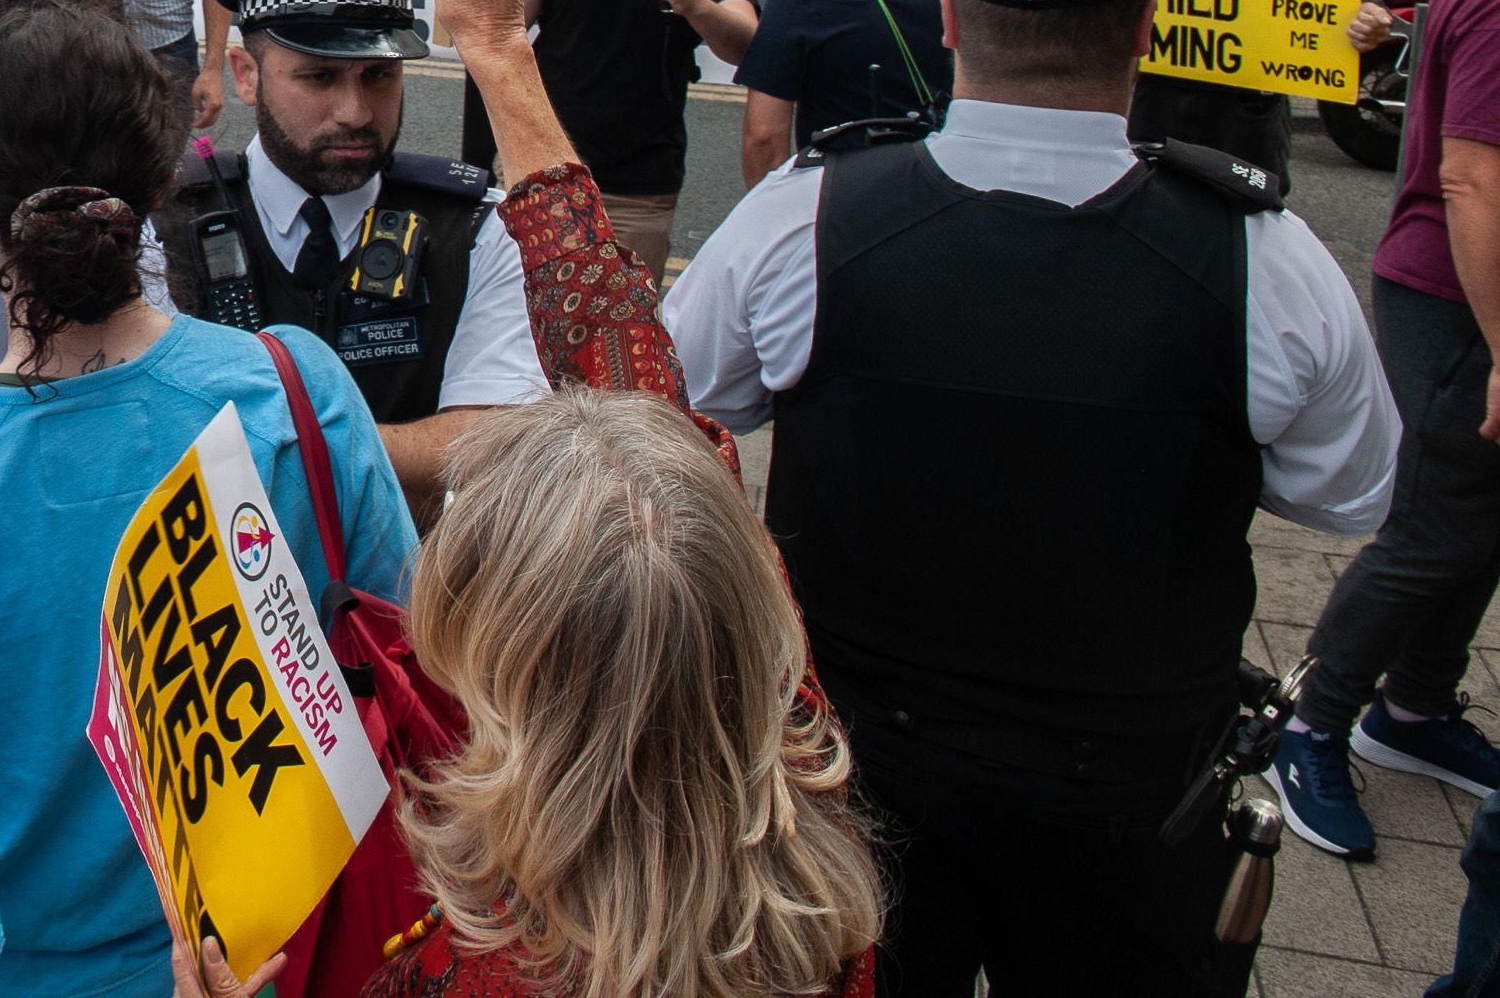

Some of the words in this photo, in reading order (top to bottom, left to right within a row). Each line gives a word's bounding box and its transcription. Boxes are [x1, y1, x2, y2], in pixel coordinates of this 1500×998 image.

[1149, 22, 1243, 75] MING
[1289, 30, 1319, 51] ME
[1260, 59, 1347, 89] WRONG
[448, 162, 465, 175] SE
[360, 321, 410, 333] METROPOLITAN
[367, 328, 404, 341] POLICE
[374, 343, 419, 357] OFFICER
[162, 472, 306, 817] BLACK
[269, 572, 320, 675] STAND
[315, 669, 344, 718] UP
[127, 520, 225, 826] LIVES
[252, 591, 279, 639] TO
[269, 636, 338, 757] RACISM
